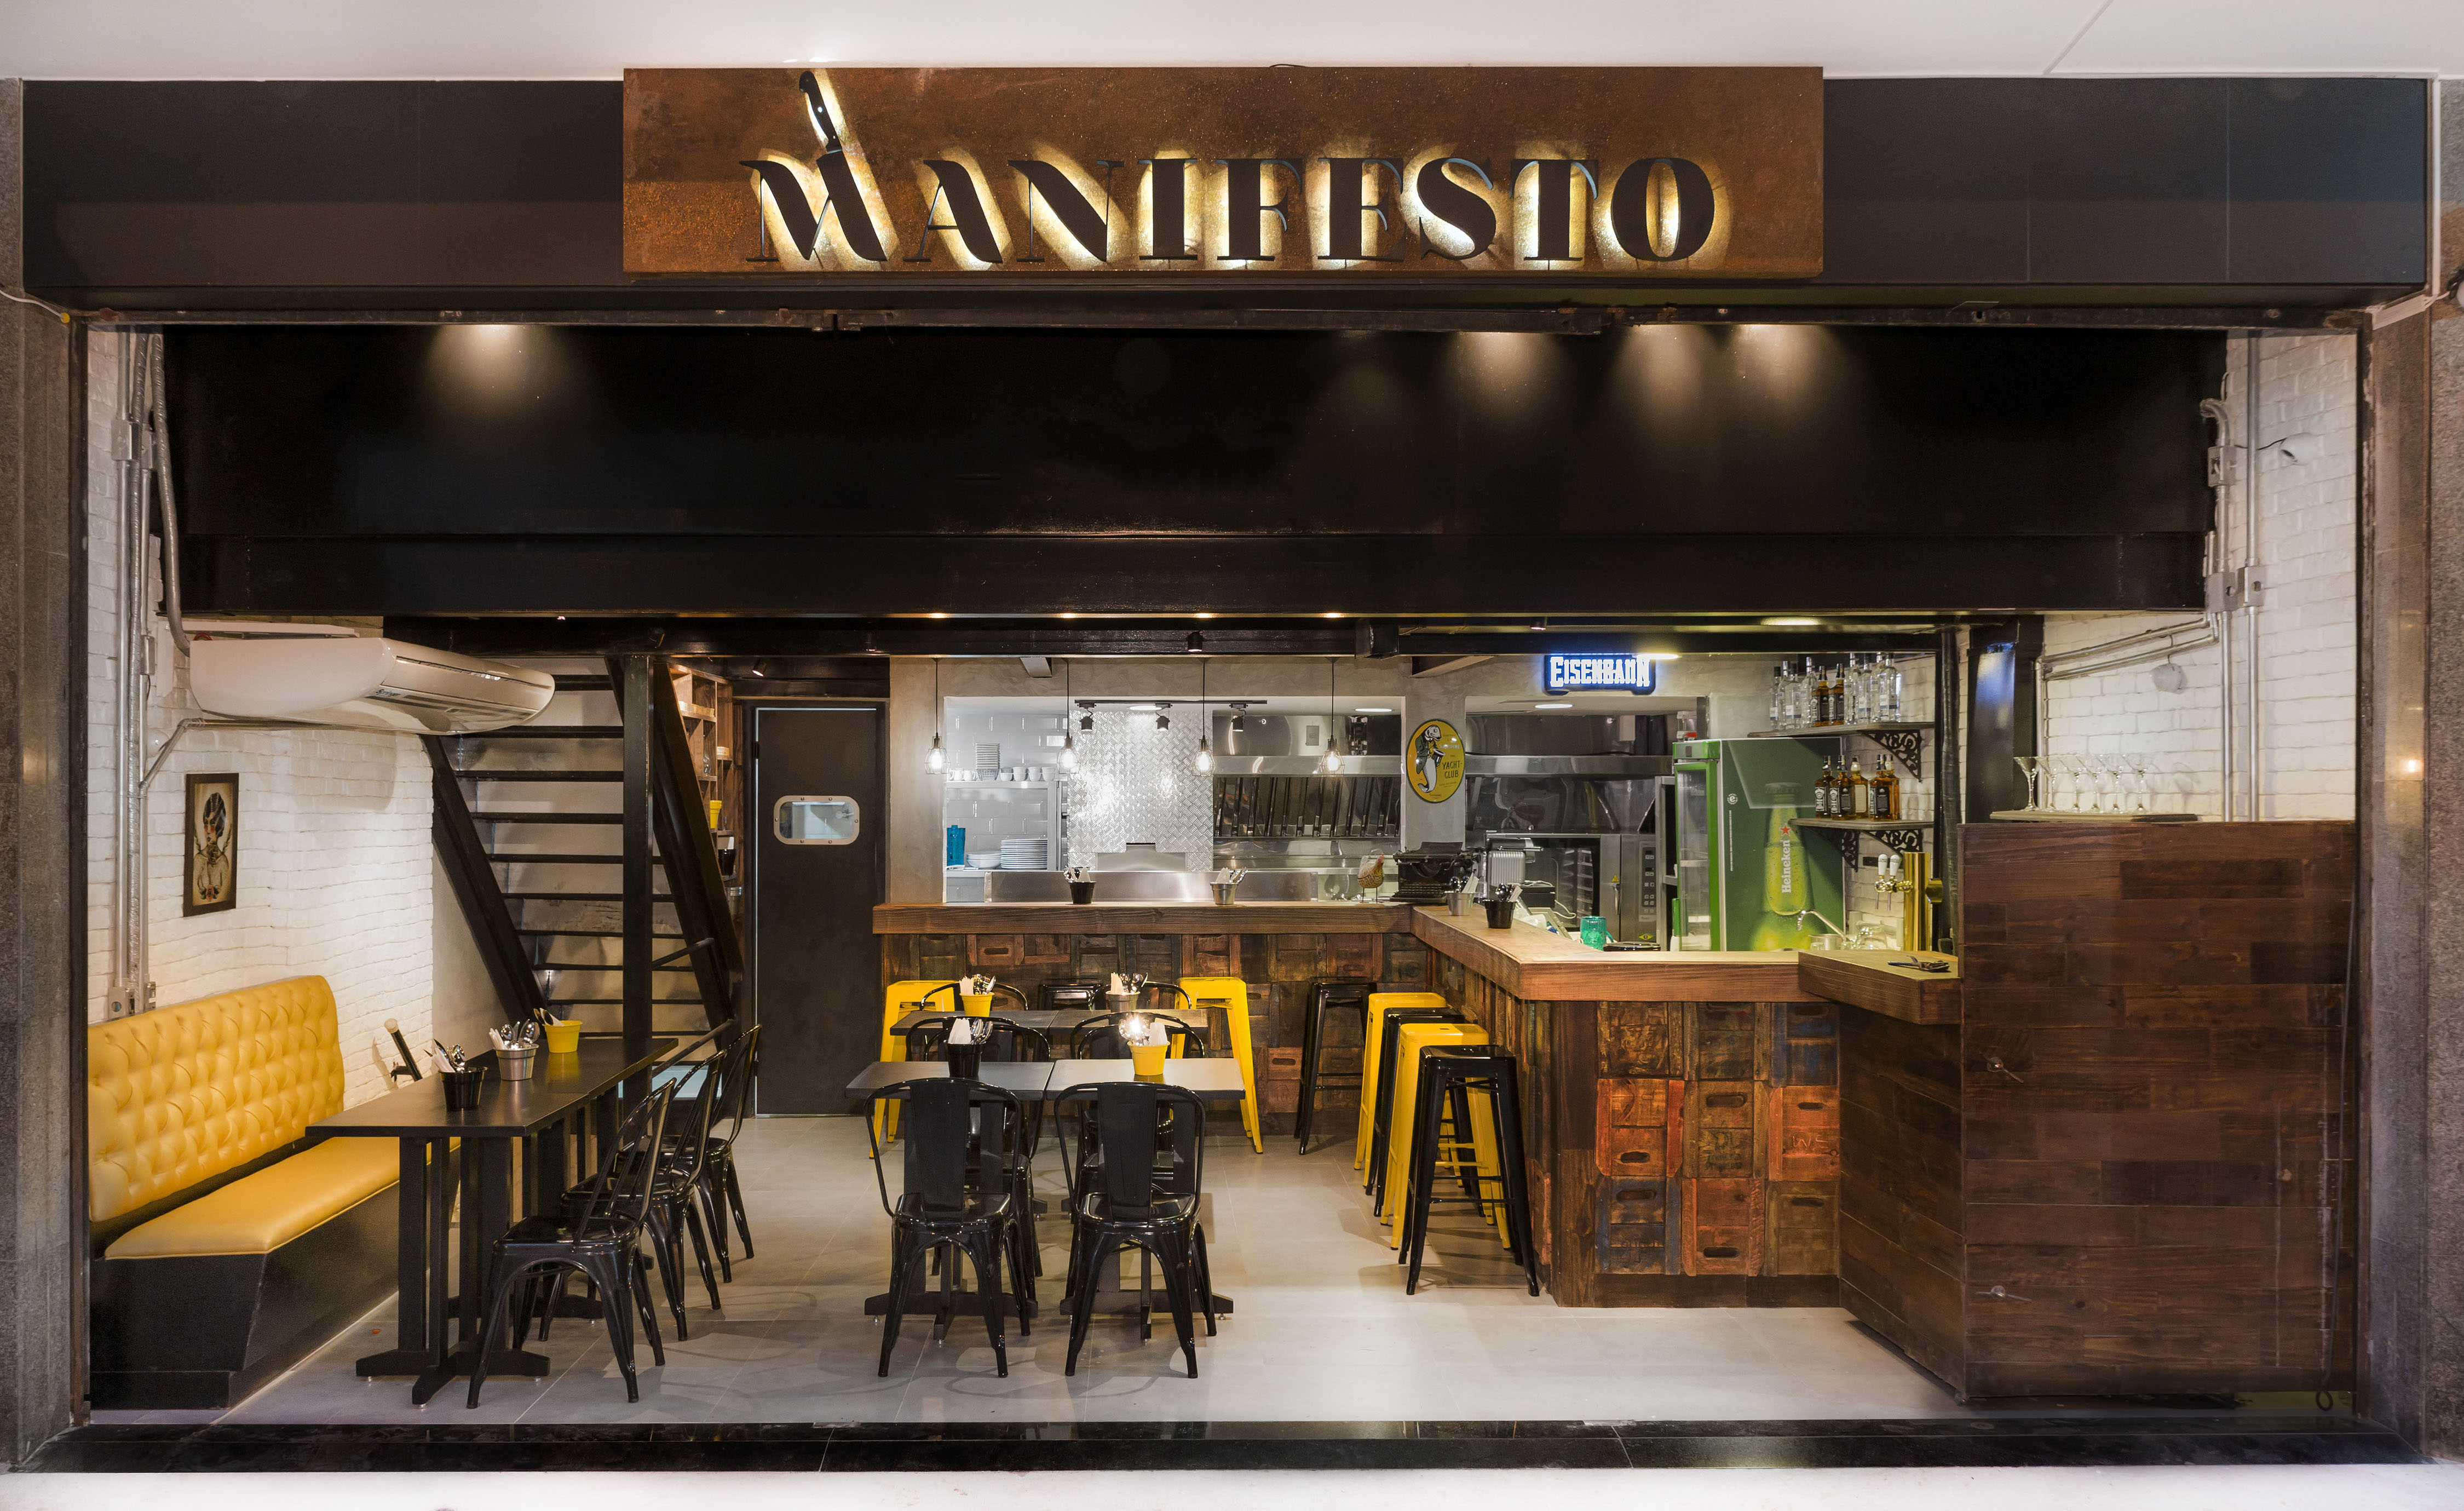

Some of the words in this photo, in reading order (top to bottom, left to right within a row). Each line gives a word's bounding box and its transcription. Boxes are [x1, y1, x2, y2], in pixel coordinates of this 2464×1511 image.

[739, 148, 1715, 263] MANIFESTO
[1444, 769, 1459, 779] CLUB
[1781, 840, 1792, 893] Heineken
